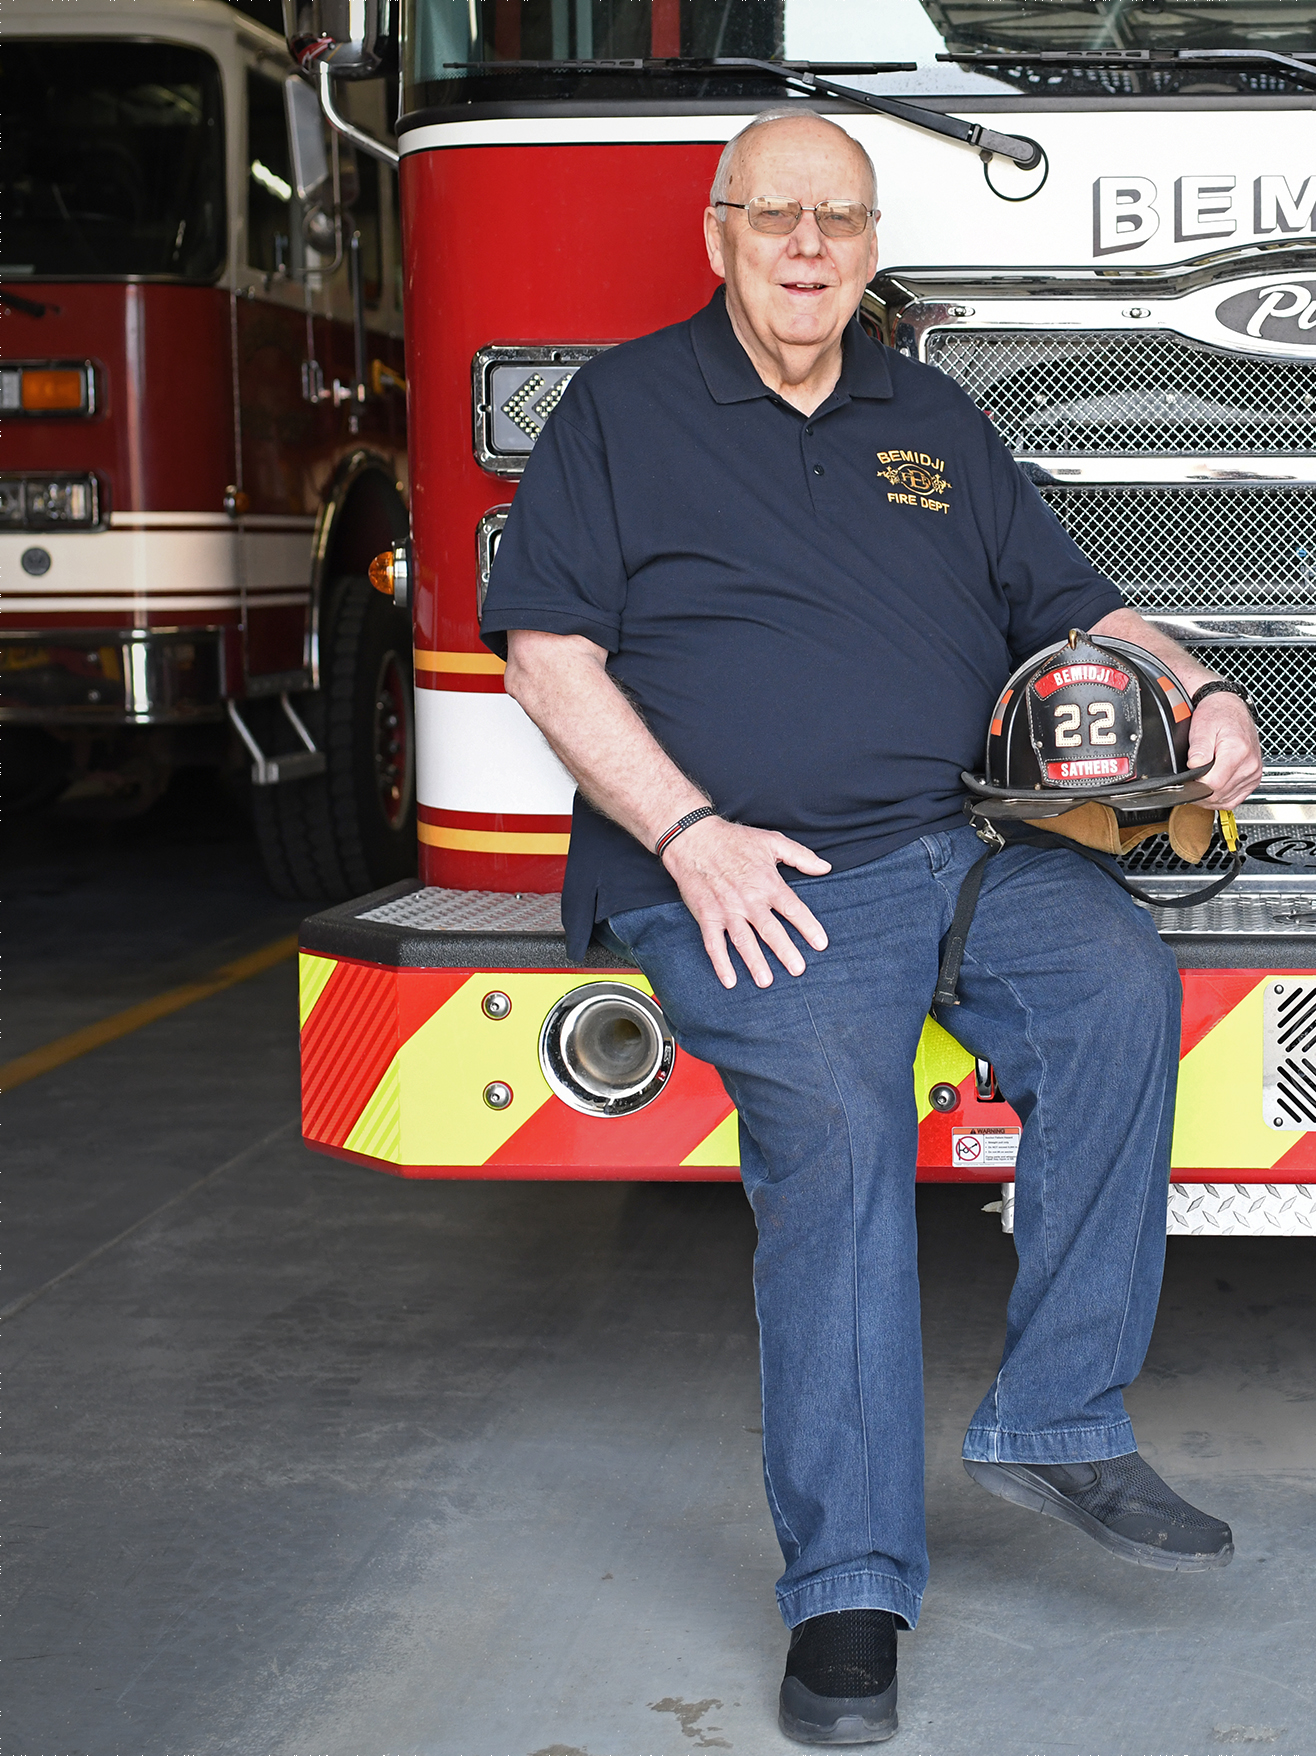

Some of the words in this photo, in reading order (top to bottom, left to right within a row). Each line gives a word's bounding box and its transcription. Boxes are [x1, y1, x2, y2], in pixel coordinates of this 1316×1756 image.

[876, 450, 945, 472] BEMIDJI
[887, 493, 918, 506] FIRE
[920, 496, 951, 515] DEPT
[1053, 666, 1111, 686] BEMIDJI
[1054, 702, 1117, 748] 22
[1061, 759, 1118, 777] SATHERS
